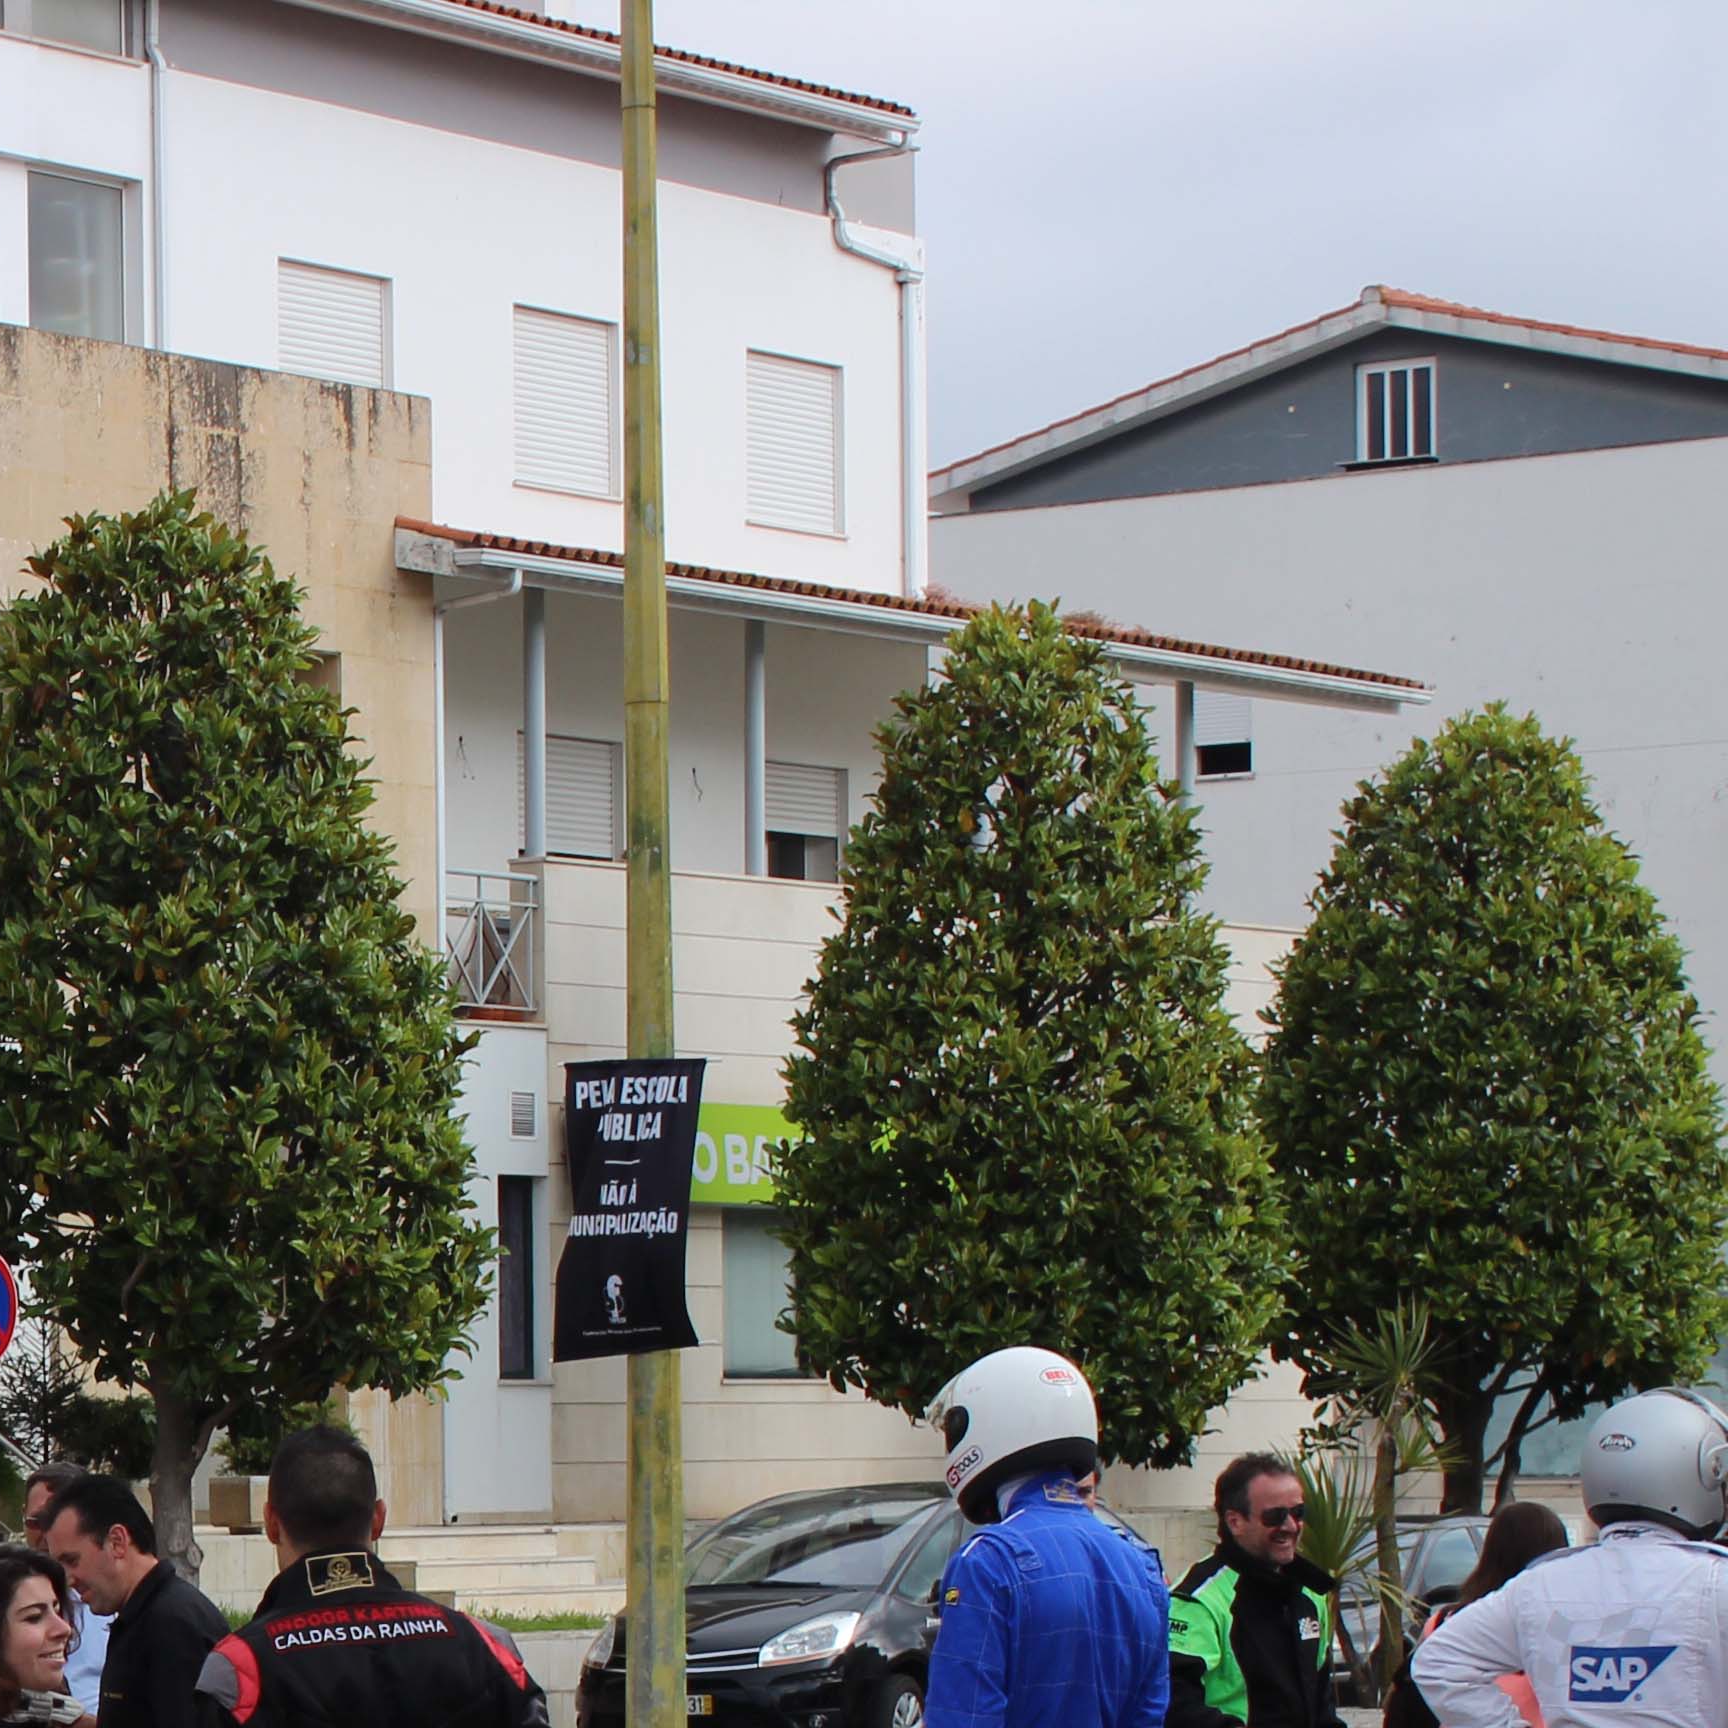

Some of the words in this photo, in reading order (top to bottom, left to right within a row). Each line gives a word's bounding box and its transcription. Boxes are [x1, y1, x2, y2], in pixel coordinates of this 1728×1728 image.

[270, 1608, 349, 1634] INDOOR
[274, 1626, 347, 1650] CALDAS
[350, 1625, 374, 1641] DA
[378, 1619, 448, 1639] RAINHA
[1571, 1656, 1648, 1692] SAP
